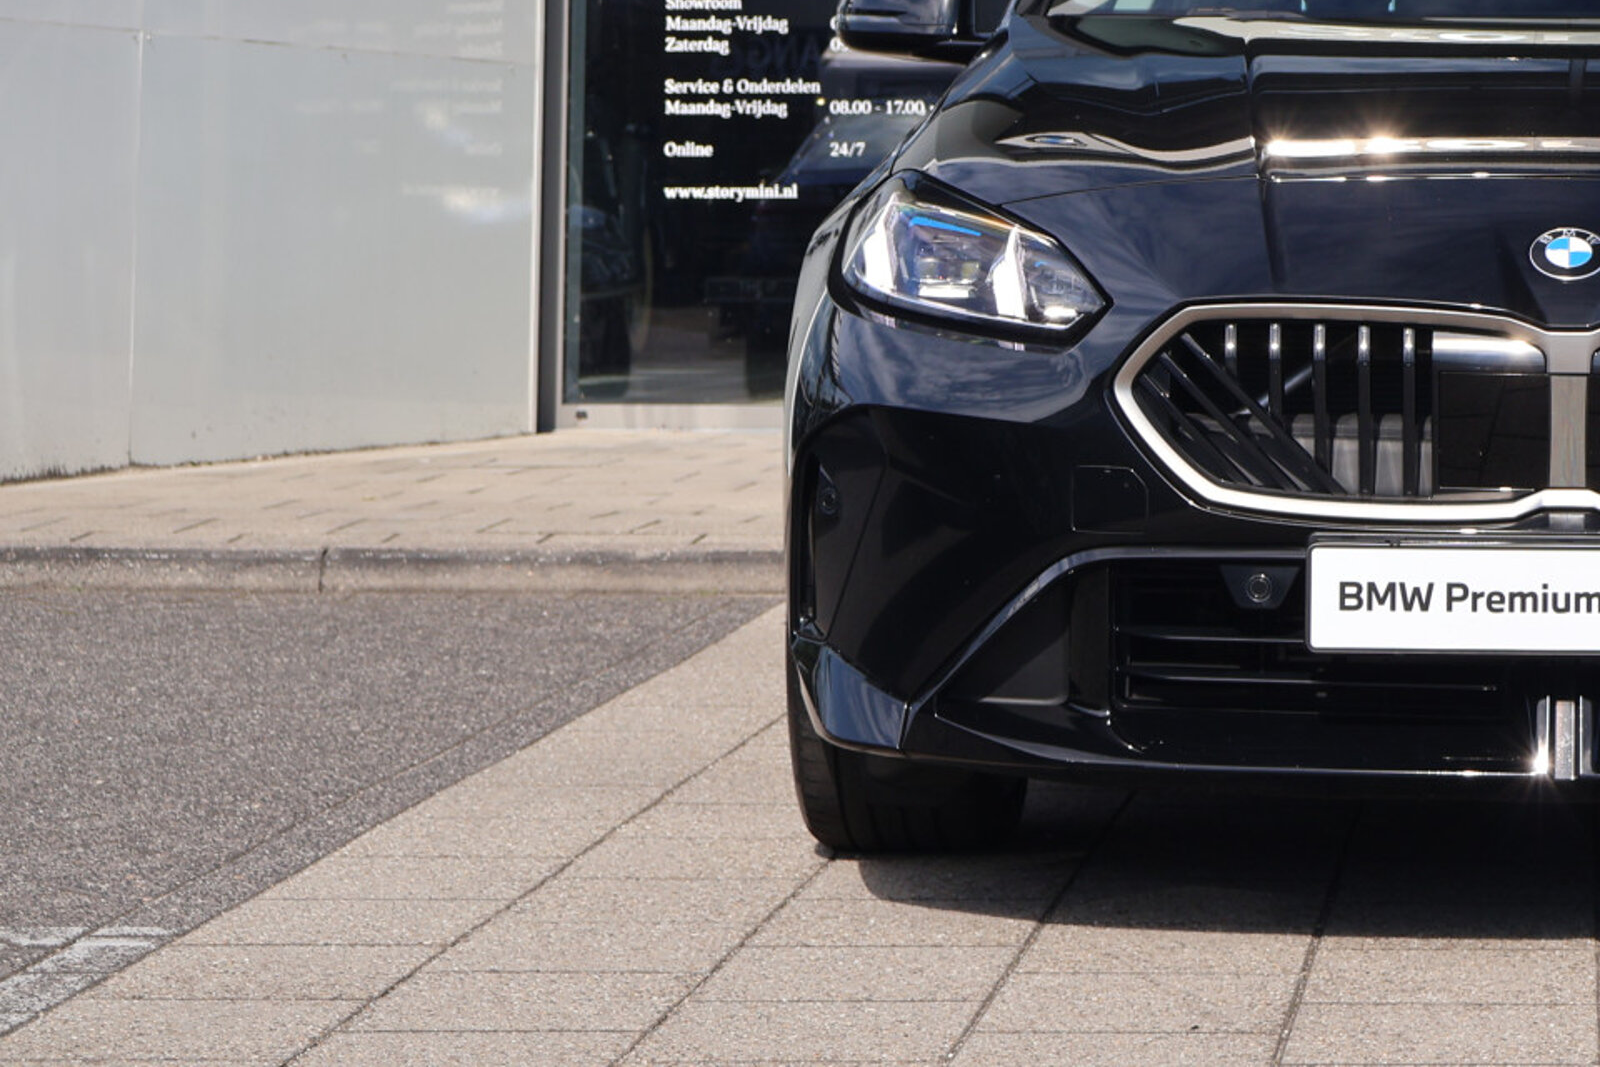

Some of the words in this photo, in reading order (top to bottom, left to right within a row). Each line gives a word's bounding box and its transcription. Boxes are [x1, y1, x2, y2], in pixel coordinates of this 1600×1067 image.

[665, 15, 789, 35] Maandag-Vrijdag
[664, 35, 731, 56] Zaterdag
[664, 78, 720, 95] Service
[722, 78, 734, 94] &
[736, 78, 821, 94] Onderdelen
[664, 98, 788, 119] Maandag-Vrijdag
[829, 100, 873, 115] 08.00
[663, 140, 714, 158] Online
[829, 141, 866, 157] 24/7
[663, 182, 799, 203] www.storymini.nl
[1338, 582, 1435, 613] BMW
